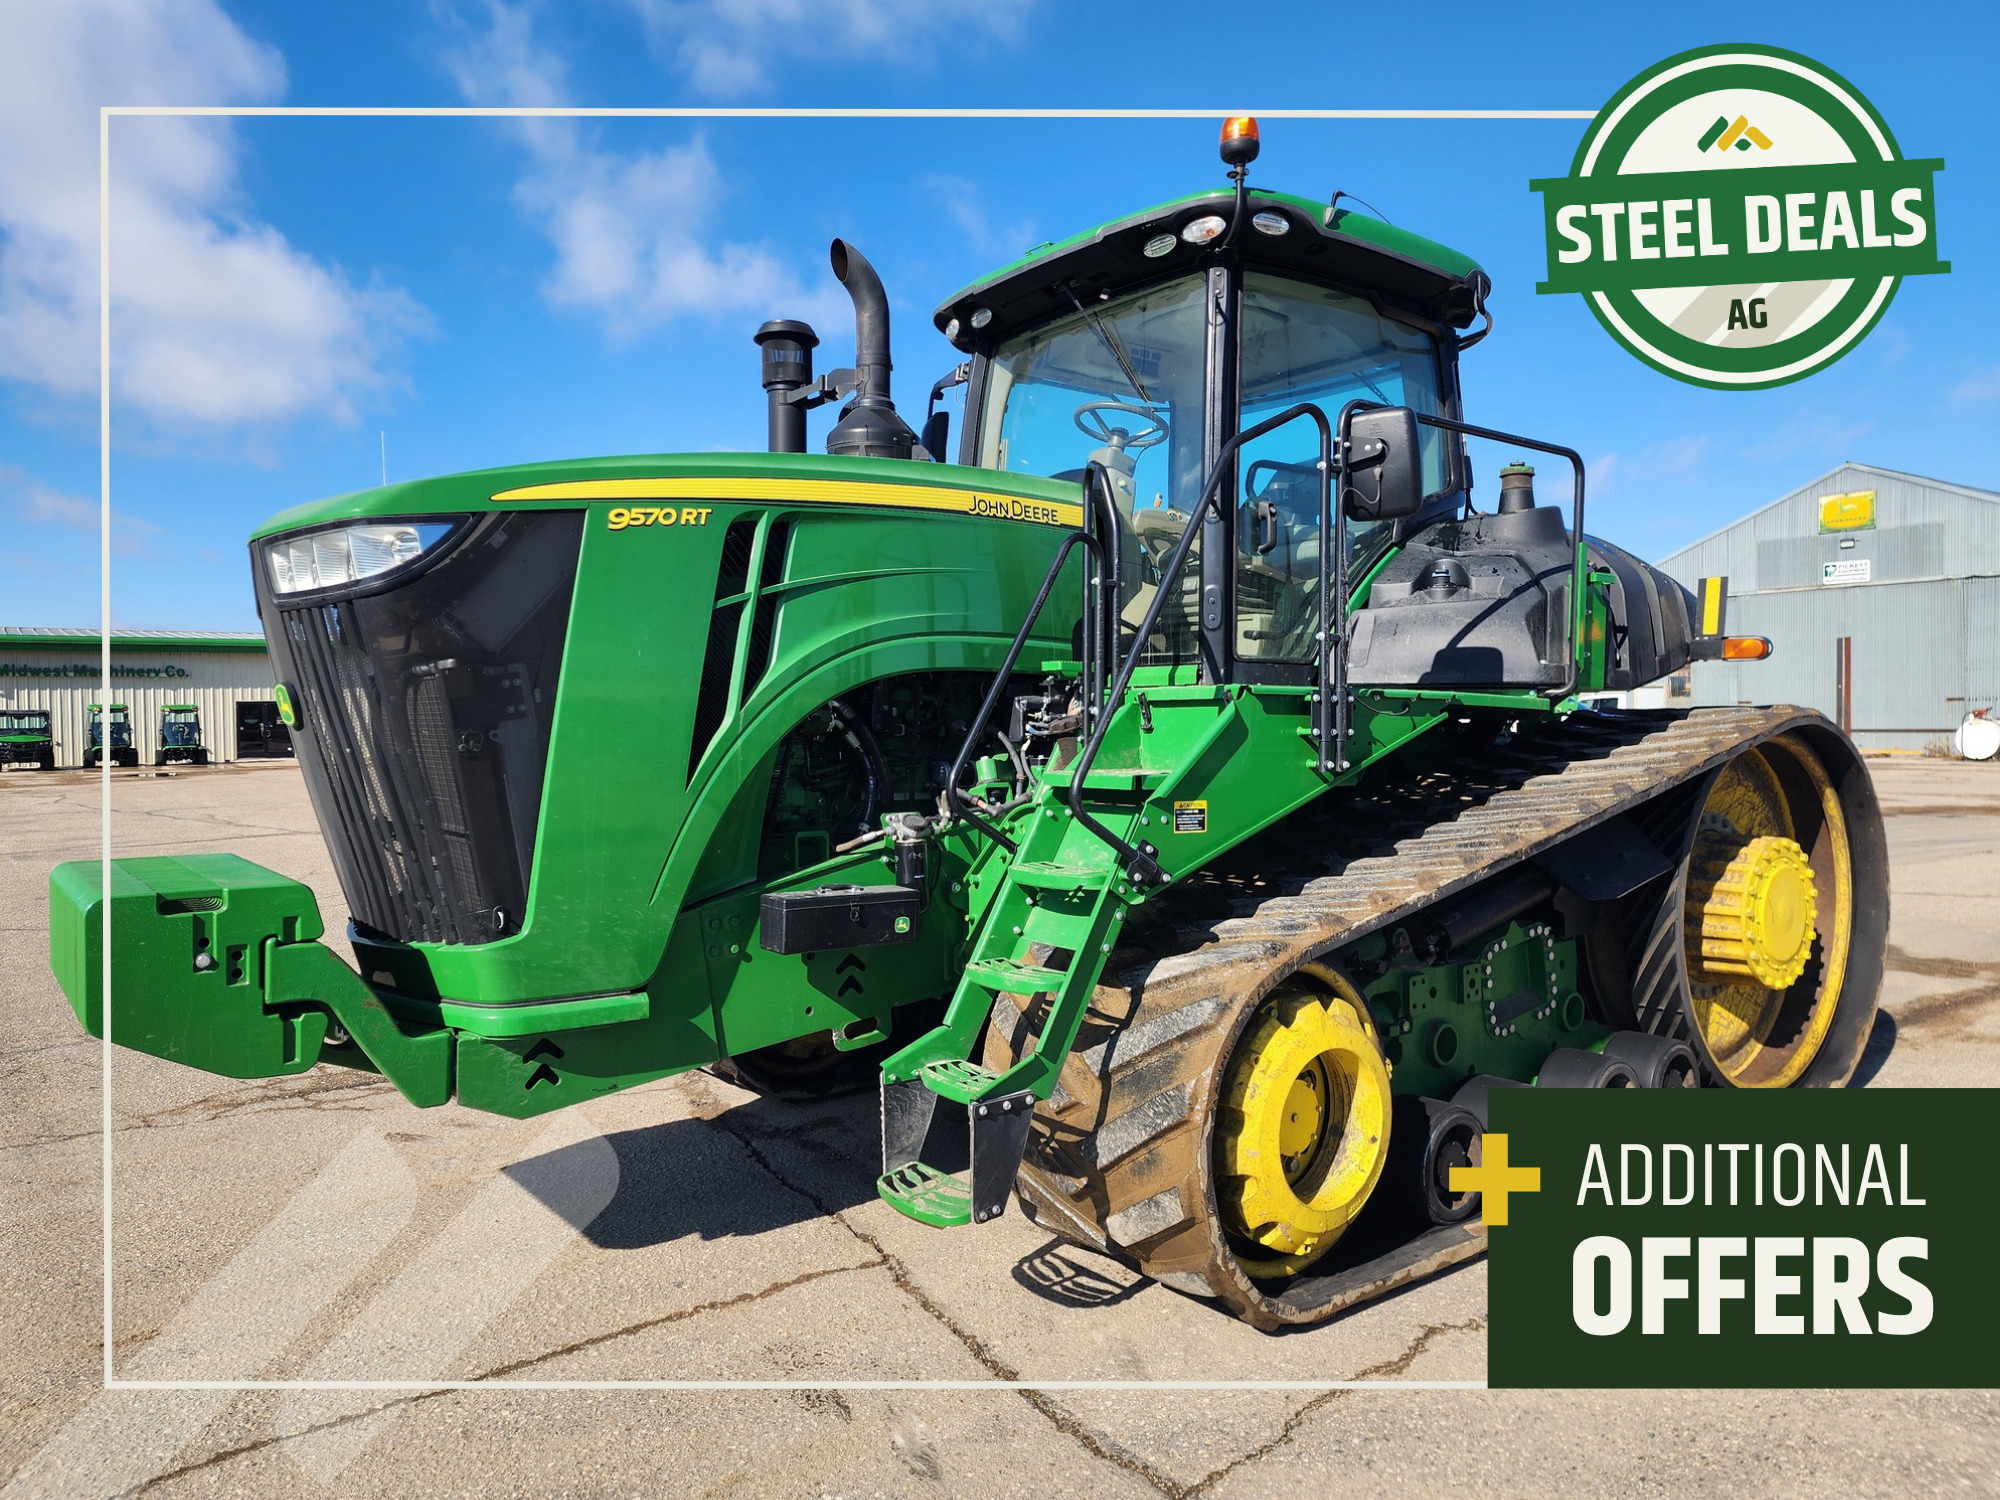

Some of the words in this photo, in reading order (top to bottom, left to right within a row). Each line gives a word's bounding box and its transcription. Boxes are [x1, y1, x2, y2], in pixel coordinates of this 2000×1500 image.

[607, 507, 678, 531] 9570
[680, 507, 713, 526] RT
[72, 664, 161, 680] Mahinery
[164, 665, 189, 677] Co.
